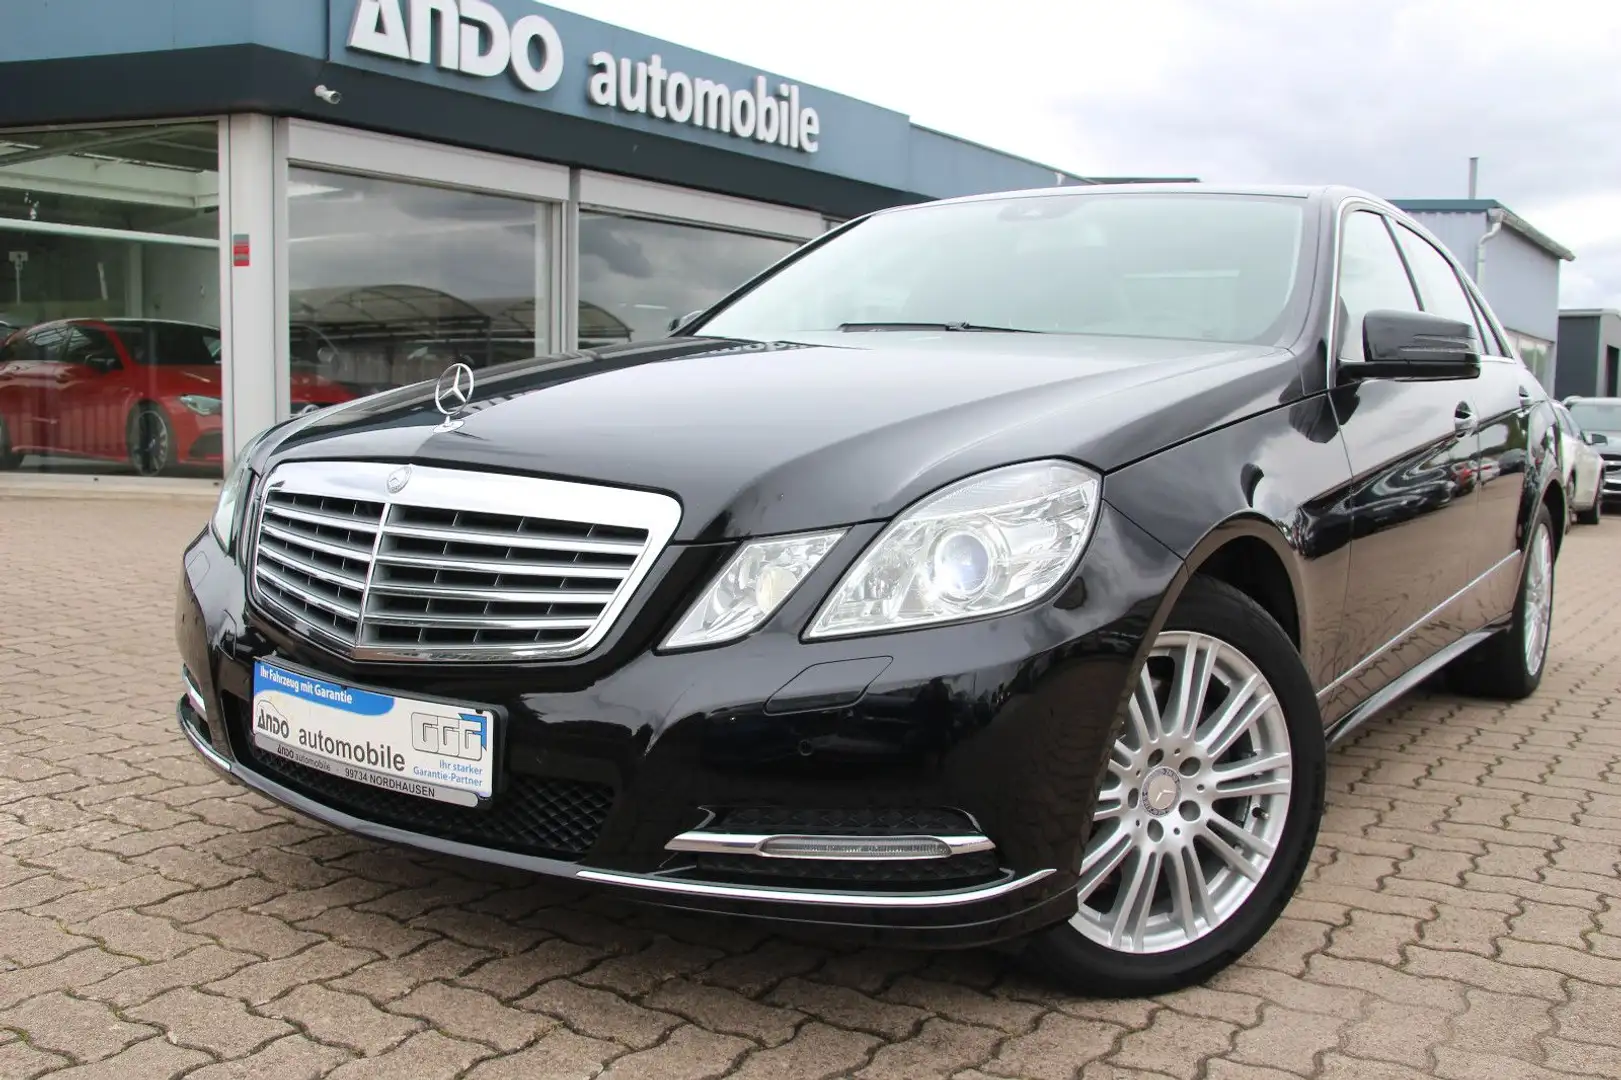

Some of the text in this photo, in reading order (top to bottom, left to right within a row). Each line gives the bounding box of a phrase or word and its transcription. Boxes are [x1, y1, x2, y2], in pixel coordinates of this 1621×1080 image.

[347, 0, 820, 154] ANDO automobile
[260, 665, 353, 704] Ihr Fahrzeug mit Garantie
[257, 708, 406, 772] ANDO automobile
[295, 753, 331, 772] automobile
[345, 767, 368, 782] 99734
[369, 774, 435, 798] NORDHAUSEN
[413, 766, 483, 786] Garantie-Partner
[439, 759, 483, 775] Ihr starker
